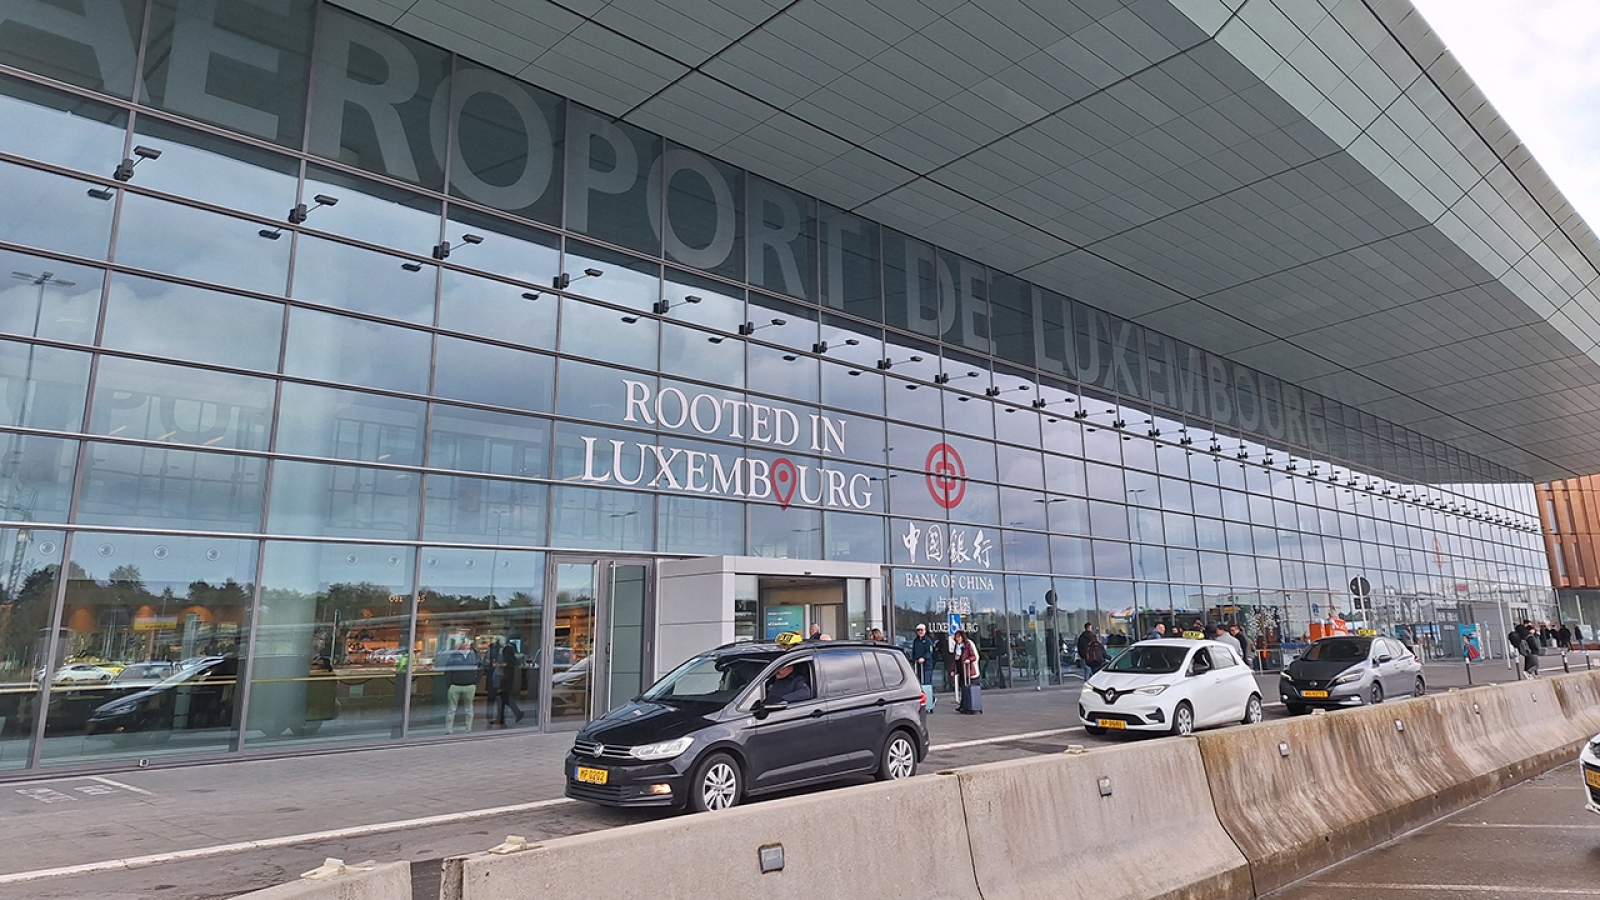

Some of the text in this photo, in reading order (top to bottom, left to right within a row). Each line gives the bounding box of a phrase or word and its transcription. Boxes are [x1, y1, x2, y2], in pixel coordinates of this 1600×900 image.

[904, 238, 997, 357] DE
[1031, 282, 1329, 452] LUXEMBOURG
[621, 378, 848, 456] ROOTED IN
[580, 435, 873, 511] LUXEMBOURG
[905, 573, 995, 591] BANK OF CHINA
[929, 622, 978, 633] LUXEURG
